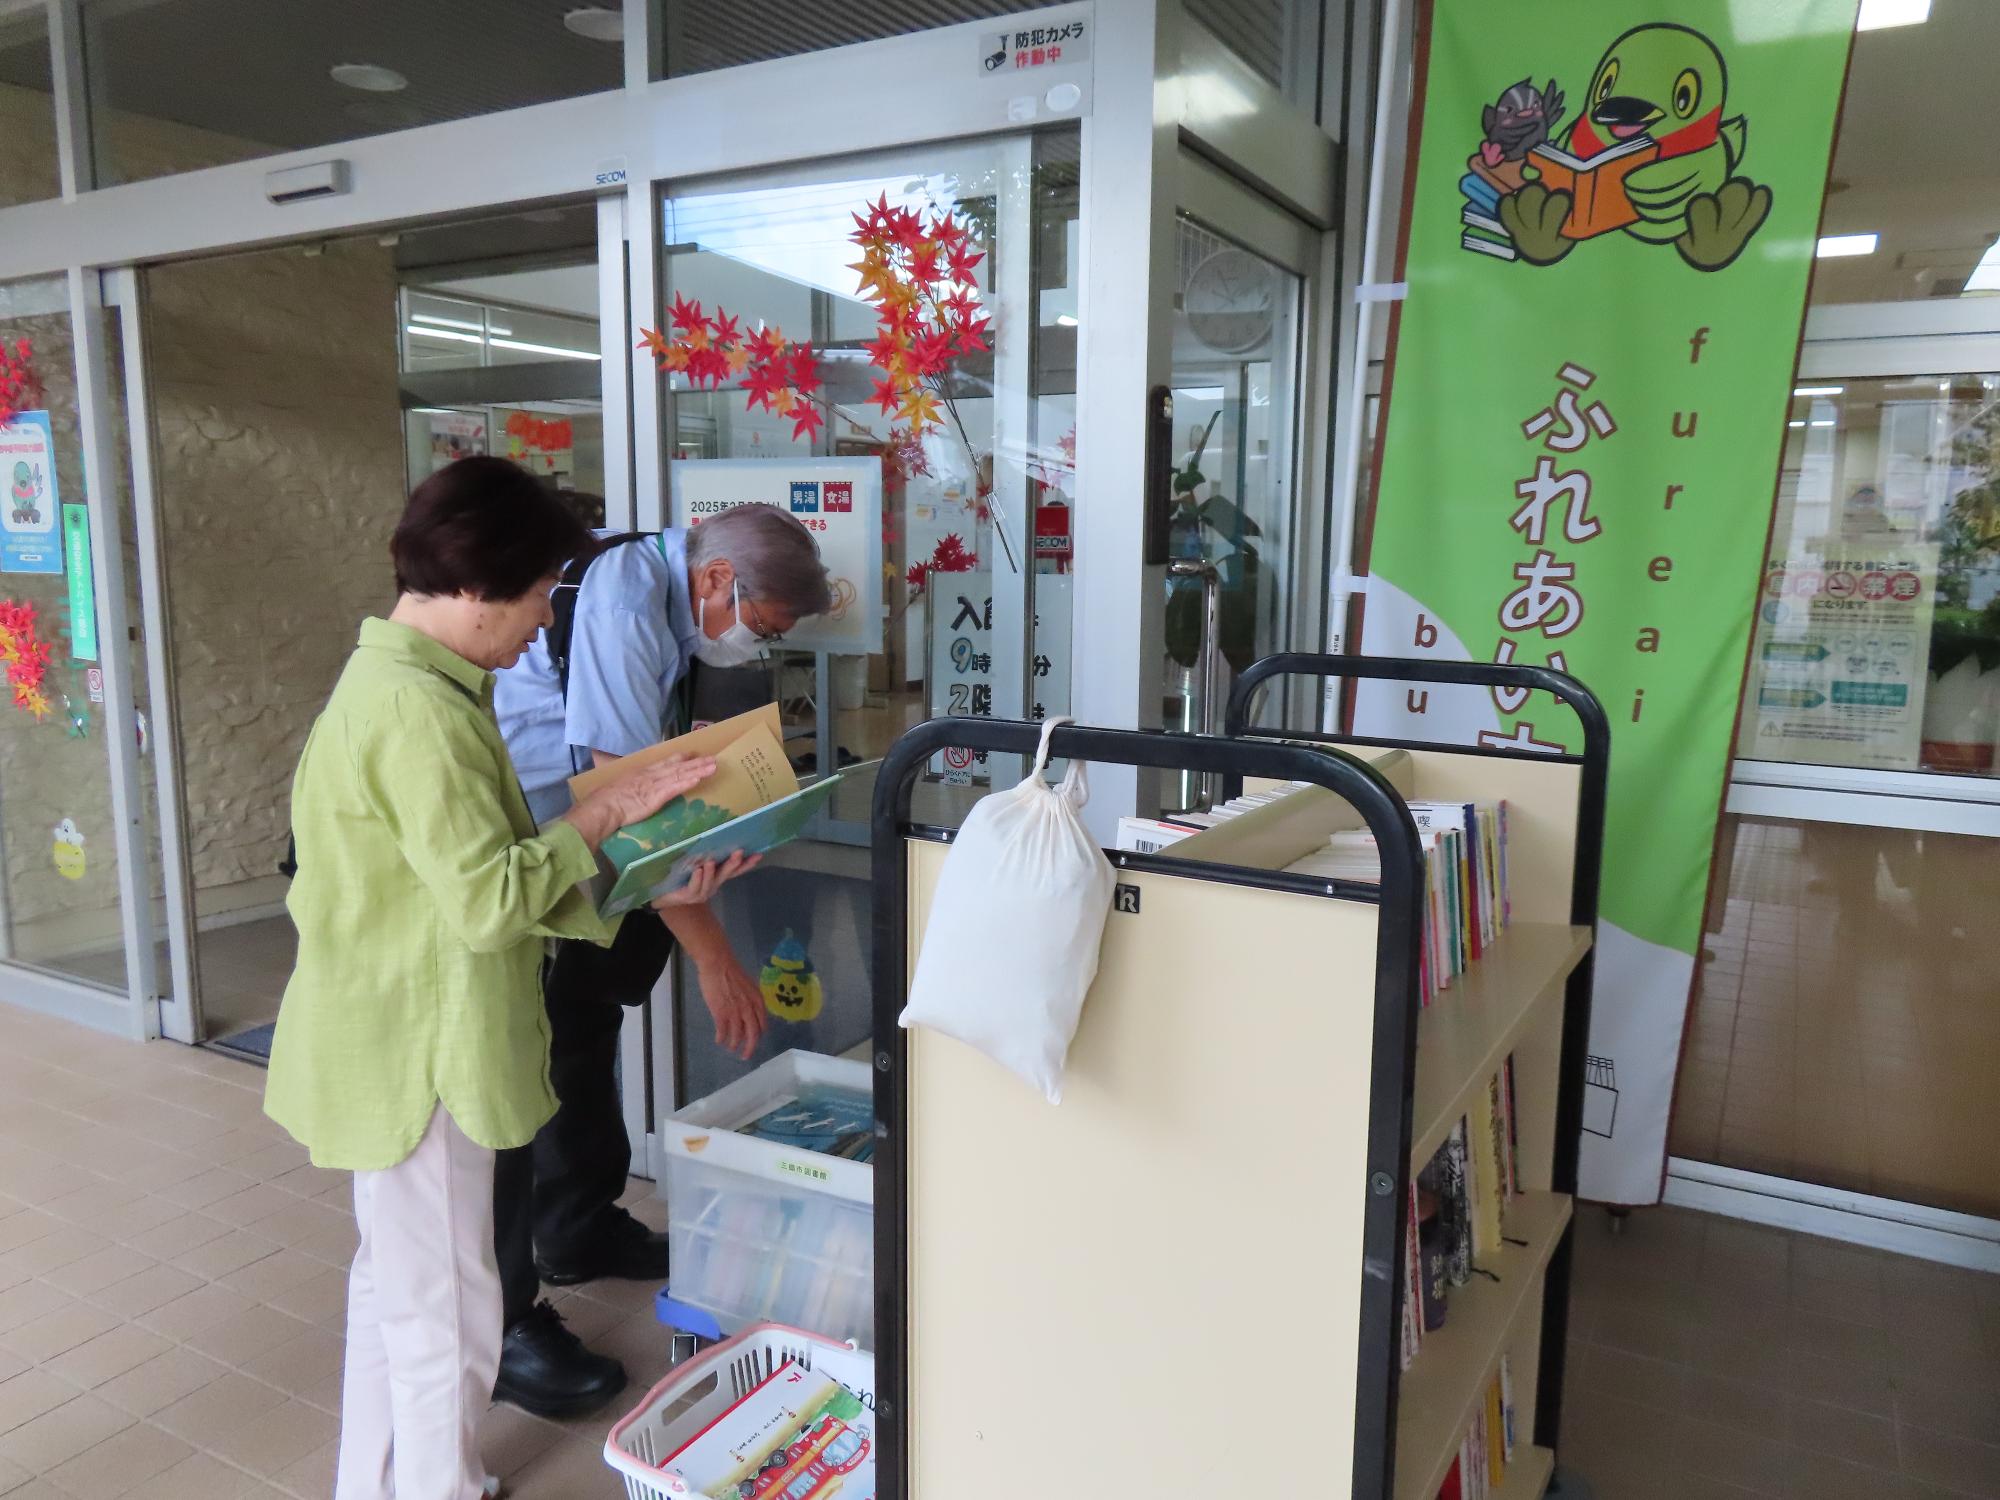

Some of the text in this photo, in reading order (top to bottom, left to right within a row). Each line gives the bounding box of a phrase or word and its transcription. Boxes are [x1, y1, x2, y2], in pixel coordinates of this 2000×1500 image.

[1015, 22, 1084, 50] 防犯カメラ
[1015, 45, 1062, 69] 作動中
[596, 169, 626, 185] SECOM
[792, 490, 850, 505] 男湯 女湯
[1631, 326, 1710, 723] fureai
